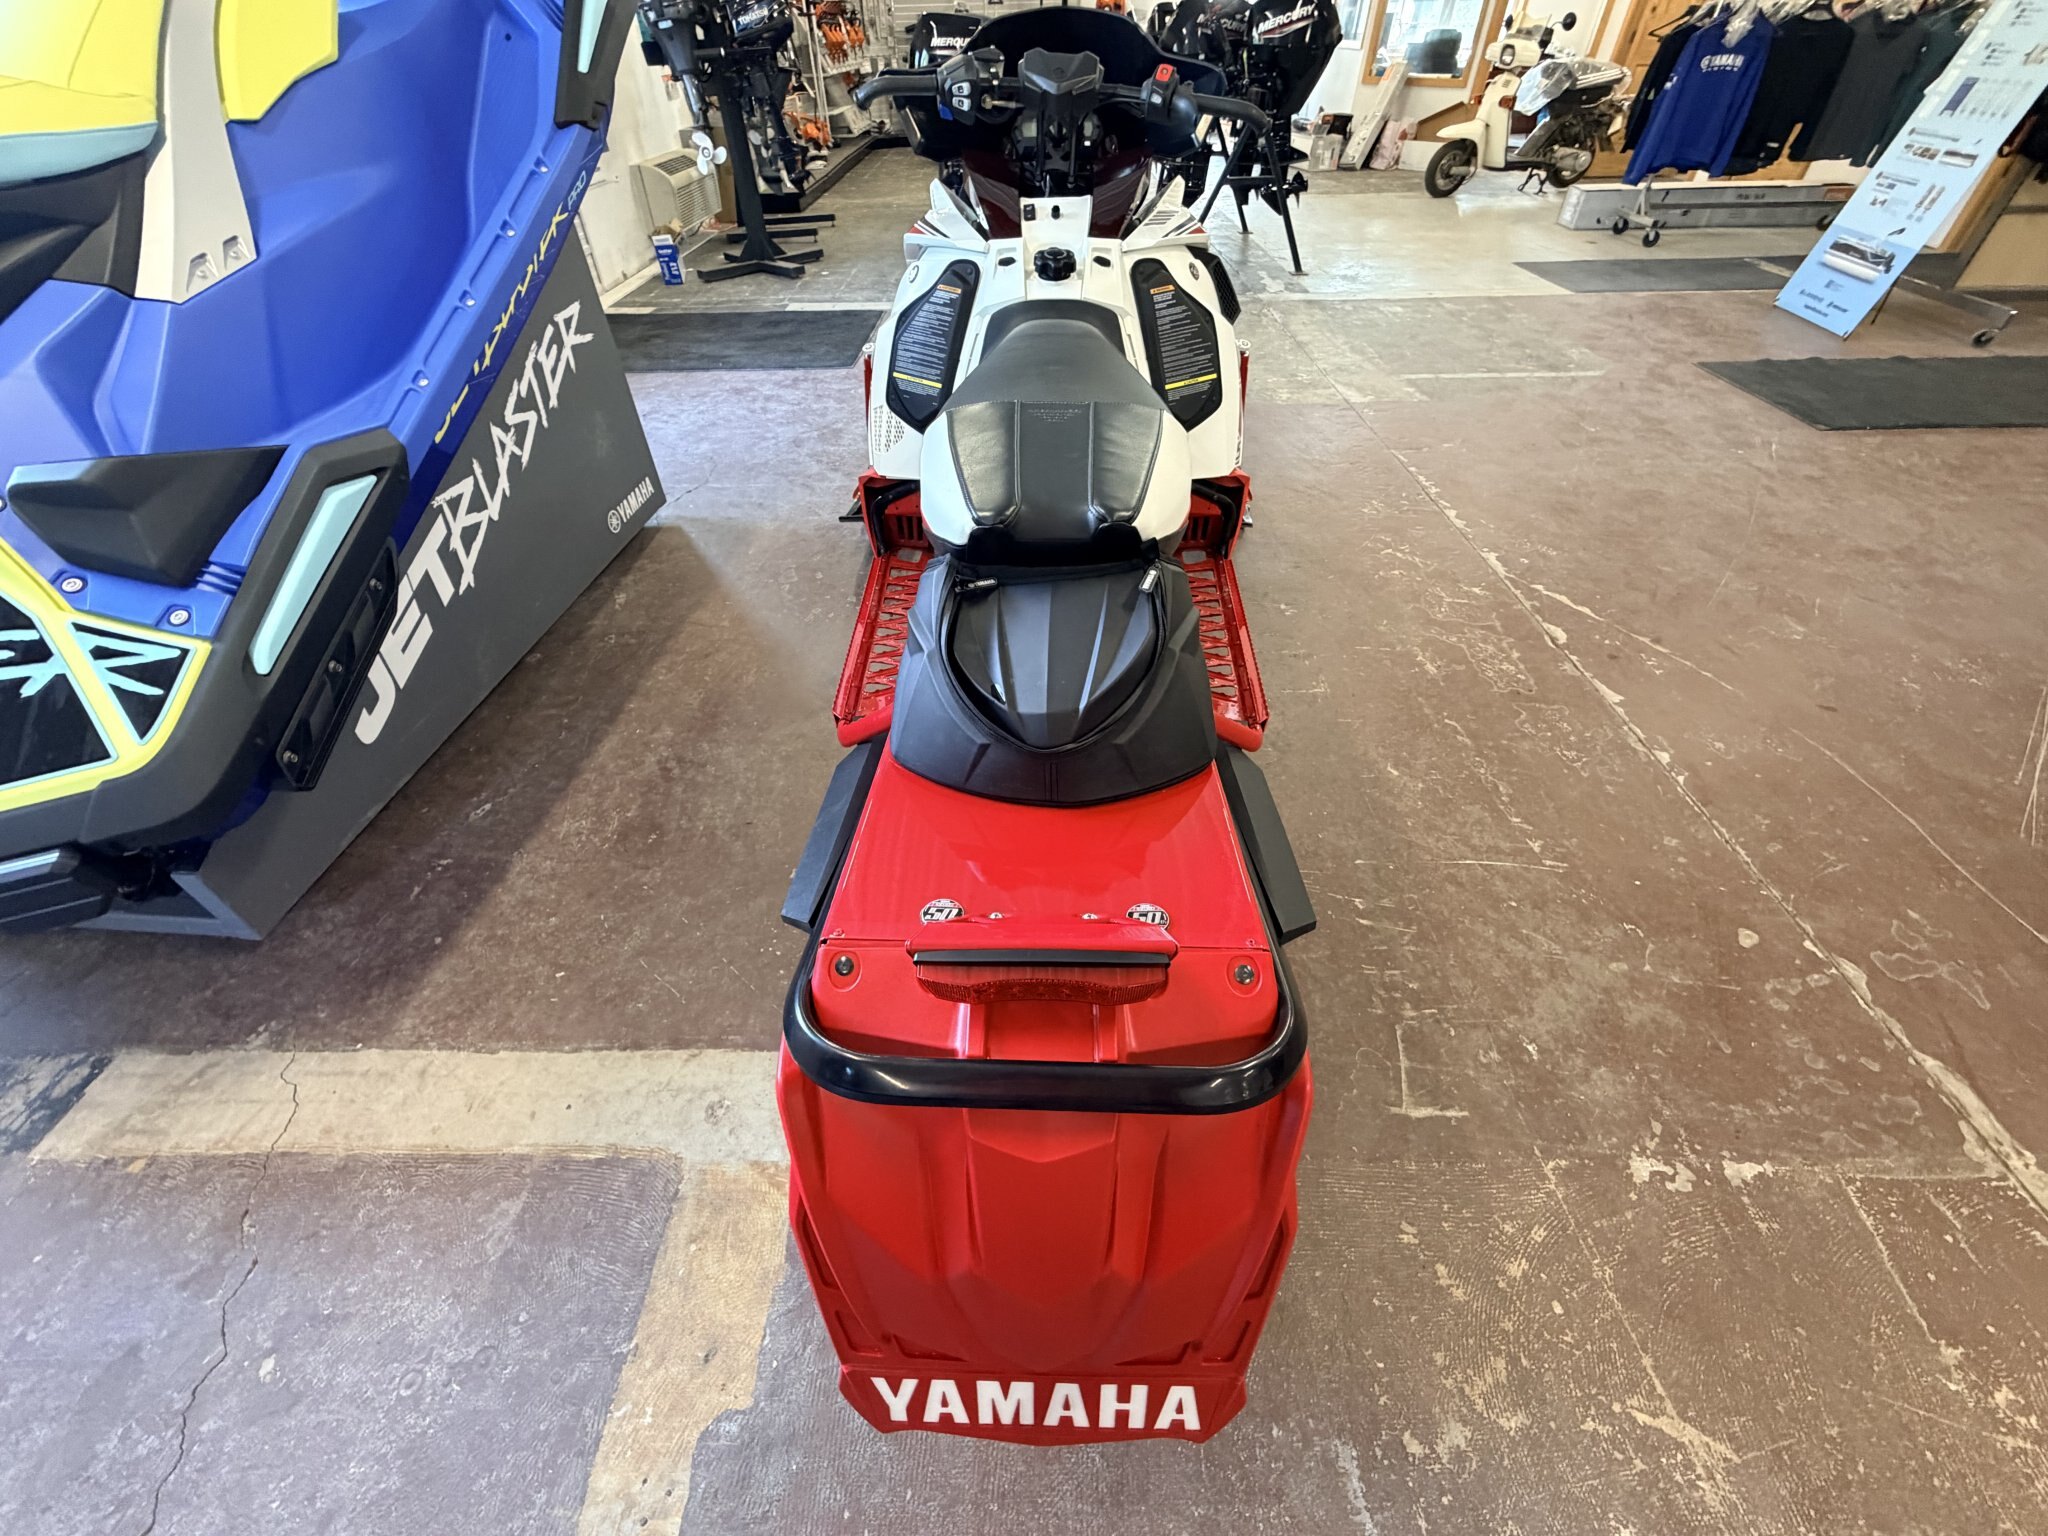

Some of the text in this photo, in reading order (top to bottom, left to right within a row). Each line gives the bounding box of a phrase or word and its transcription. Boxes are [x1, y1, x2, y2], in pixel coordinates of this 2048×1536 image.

[1257, 3, 1317, 34] MERCURY
[567, 169, 587, 211] PRO
[616, 476, 655, 523] YAMAHA
[869, 1376, 1202, 1431] YAMAHA
